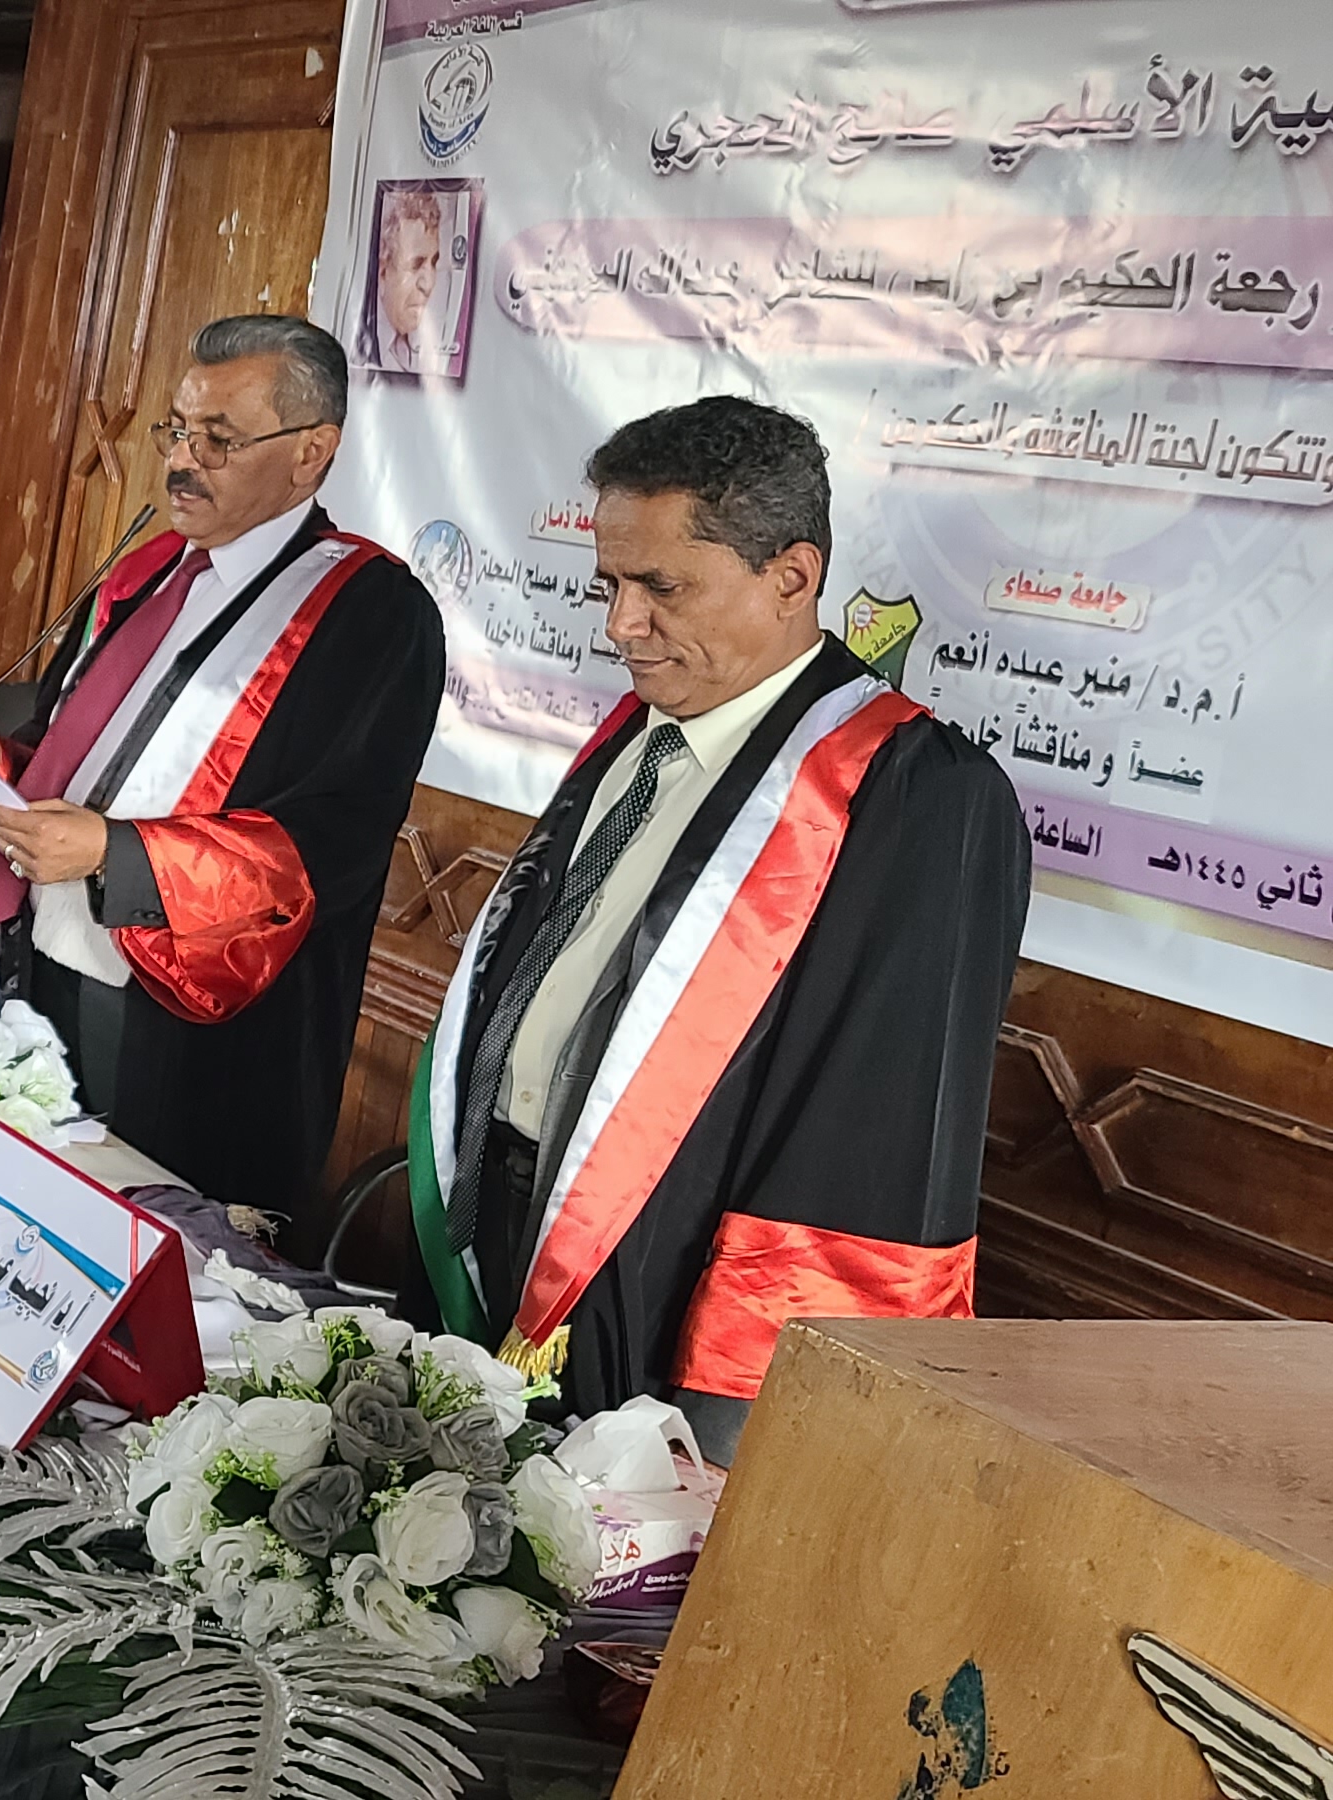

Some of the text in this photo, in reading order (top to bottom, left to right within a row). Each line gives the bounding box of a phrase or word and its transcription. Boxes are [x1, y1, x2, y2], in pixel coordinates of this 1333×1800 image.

[1058, 249, 1197, 322] الحكيم
[1210, 252, 1321, 332] رجعة
[1023, 406, 1148, 468] المناقشة
[1145, 418, 1219, 481] لجنة
[1216, 428, 1333, 494] وتتكون
[522, 562, 558, 600] مصلح
[928, 629, 992, 678] أنعم
[993, 648, 1066, 696] عبده
[1068, 654, 1132, 711] منير
[1032, 805, 1104, 857] الساعة
[1256, 863, 1325, 911] ثاني
